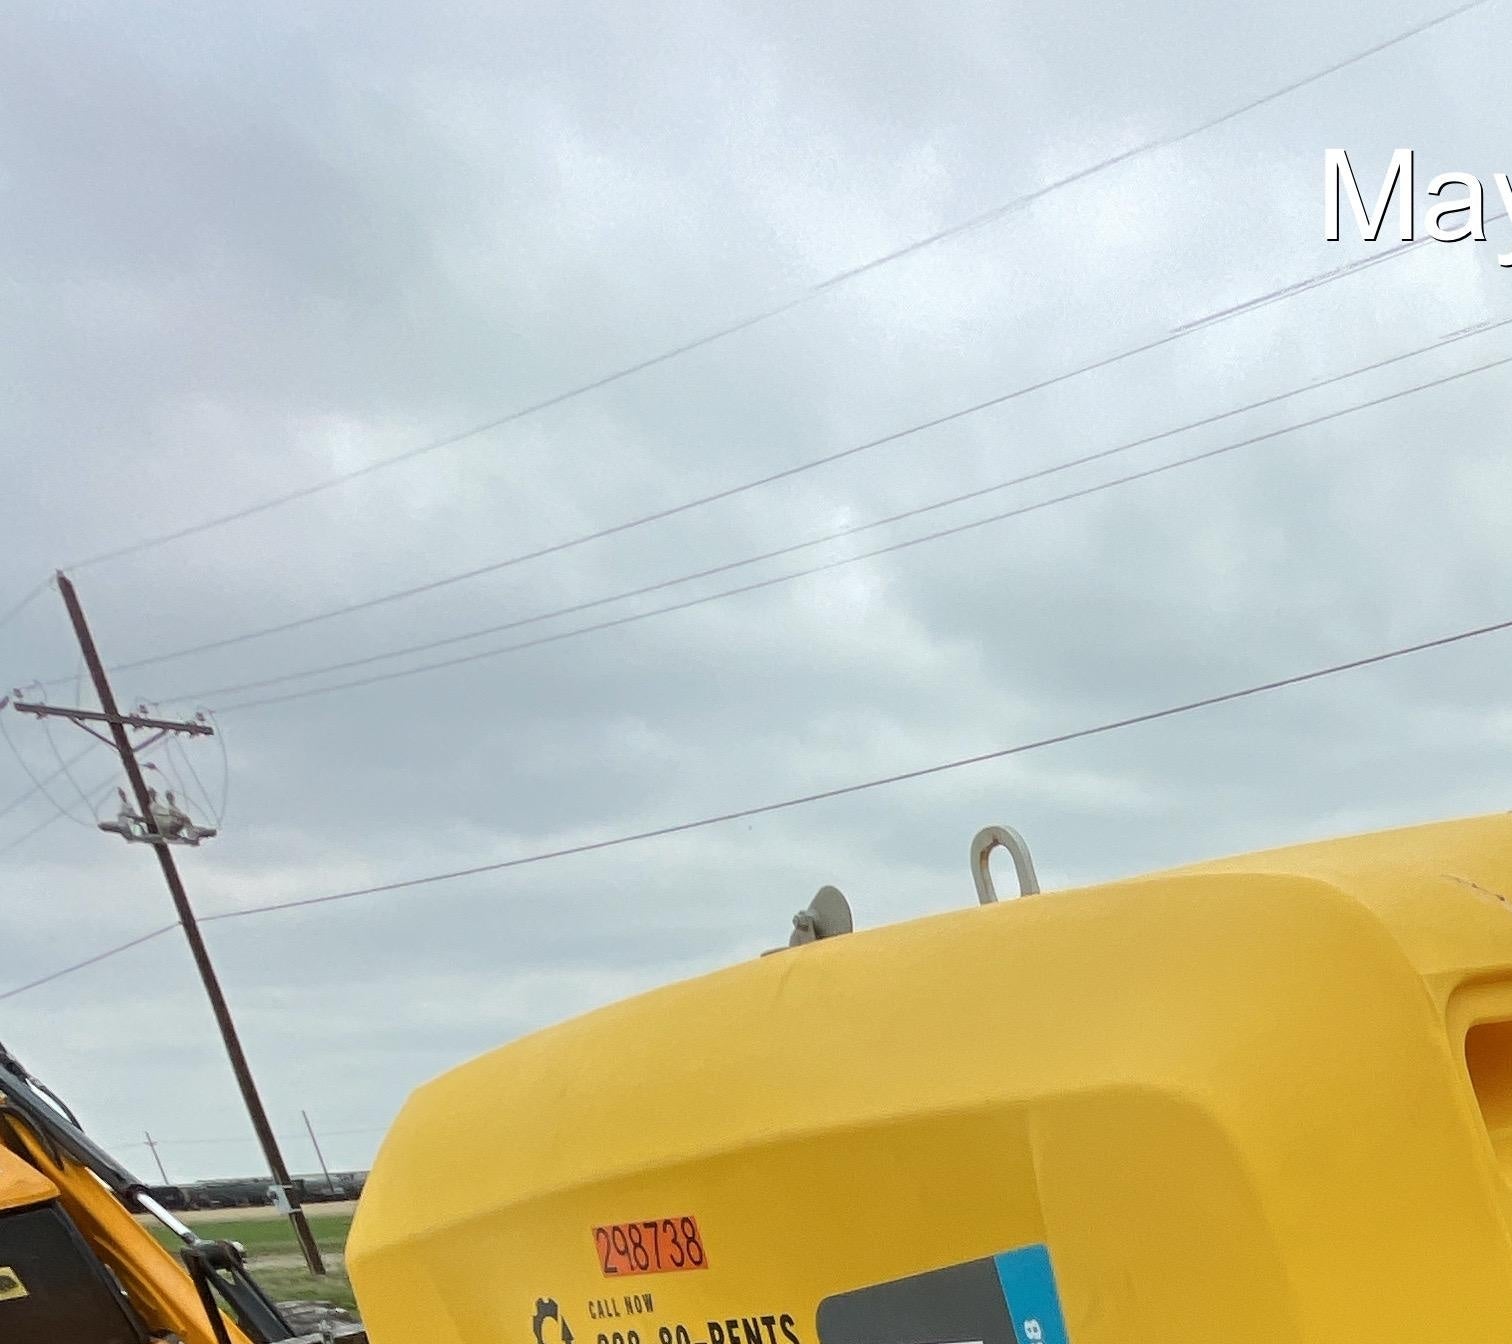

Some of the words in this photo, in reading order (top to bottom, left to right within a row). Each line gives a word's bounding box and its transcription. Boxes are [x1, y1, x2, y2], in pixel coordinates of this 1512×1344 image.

[596, 1217, 703, 1274] 298738
[588, 1300, 620, 1319] CALL
[624, 1293, 654, 1315] NOW
